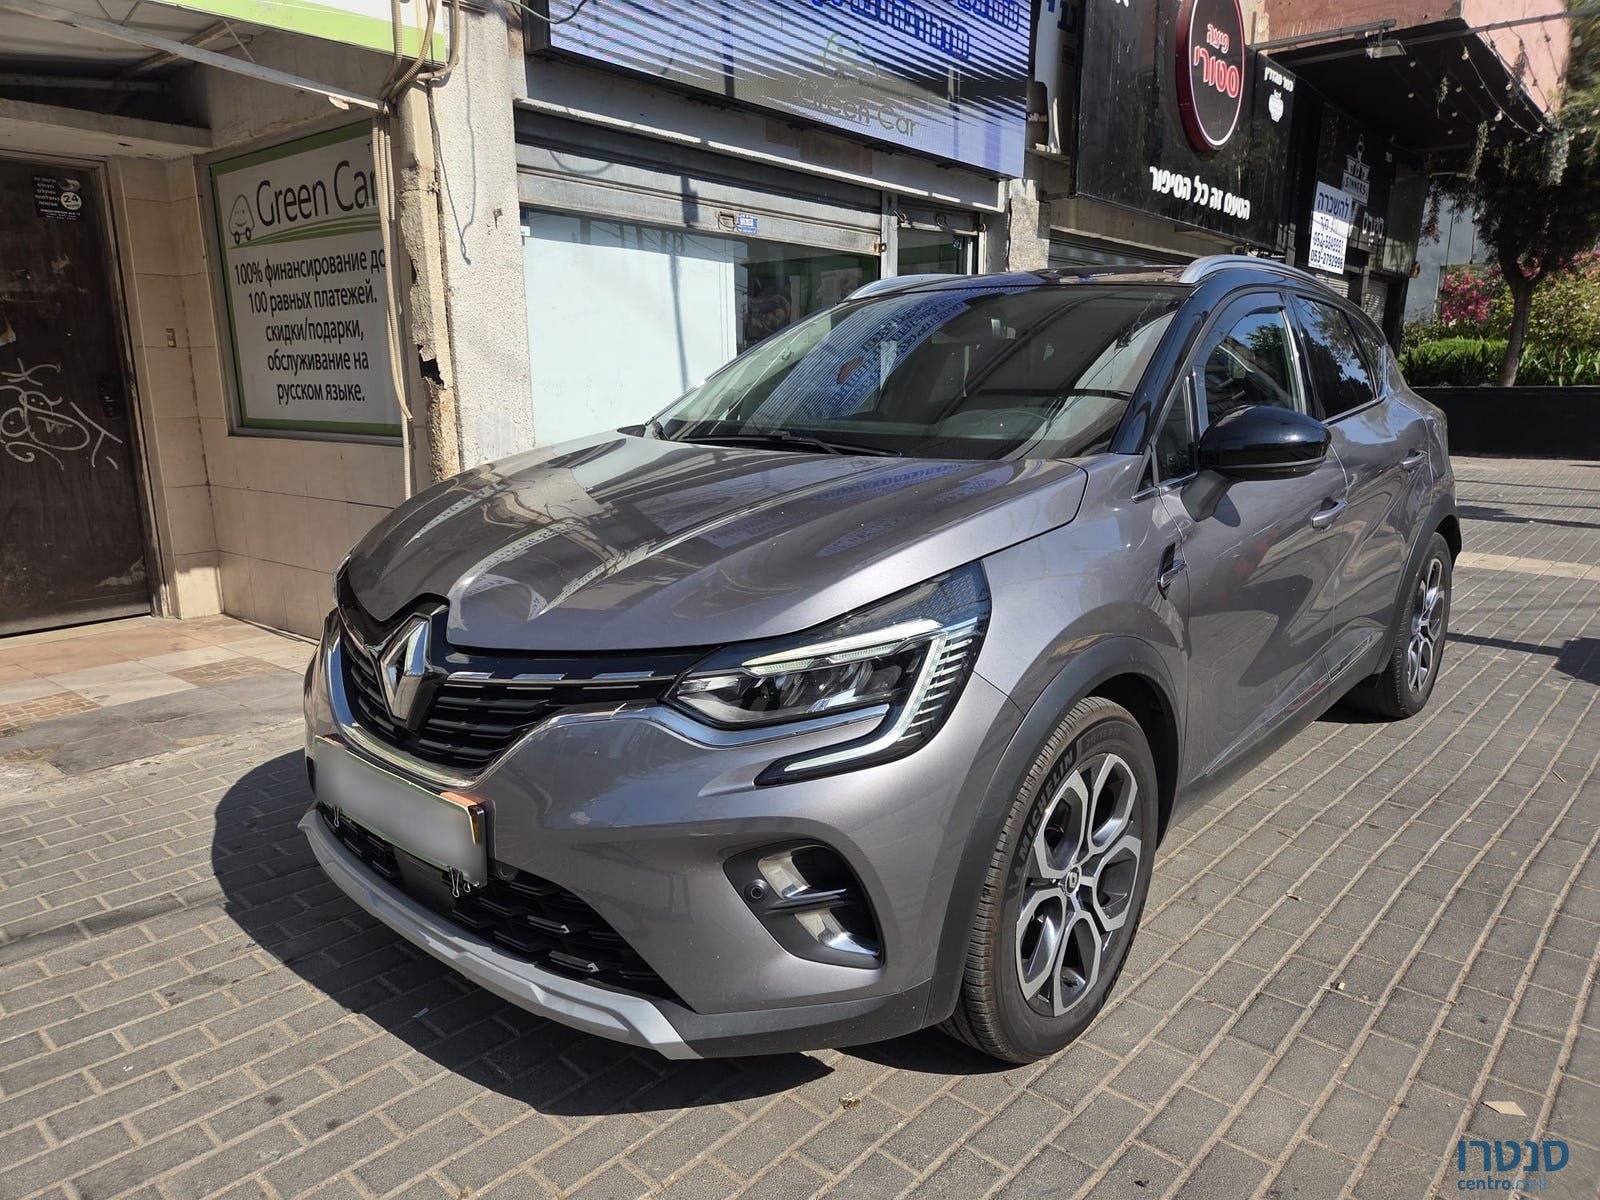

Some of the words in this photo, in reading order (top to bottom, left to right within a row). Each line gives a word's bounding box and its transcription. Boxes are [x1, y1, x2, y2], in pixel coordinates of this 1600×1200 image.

[1206, 23, 1230, 53] פיצה
[1194, 45, 1239, 98] סטורי
[63, 194, 79, 203] 24
[1149, 166, 1192, 201] הסיפור
[1193, 175, 1209, 205] כל
[1209, 187, 1224, 210] זה
[256, 180, 329, 226] Green
[1223, 192, 1251, 220] הטעם
[1317, 192, 1350, 219] להשכרה
[235, 261, 263, 286] 100%
[265, 253, 367, 287] финансирование
[249, 291, 268, 314] 100
[270, 291, 312, 317] равных
[314, 279, 378, 308] платежей.
[265, 317, 364, 345] скидки/подарки,
[267, 349, 350, 376] обслуживание
[353, 351, 369, 370] на
[277, 383, 323, 405] русском
[325, 383, 365, 402] языке.
[1018, 749, 1074, 860] MICHELIN
